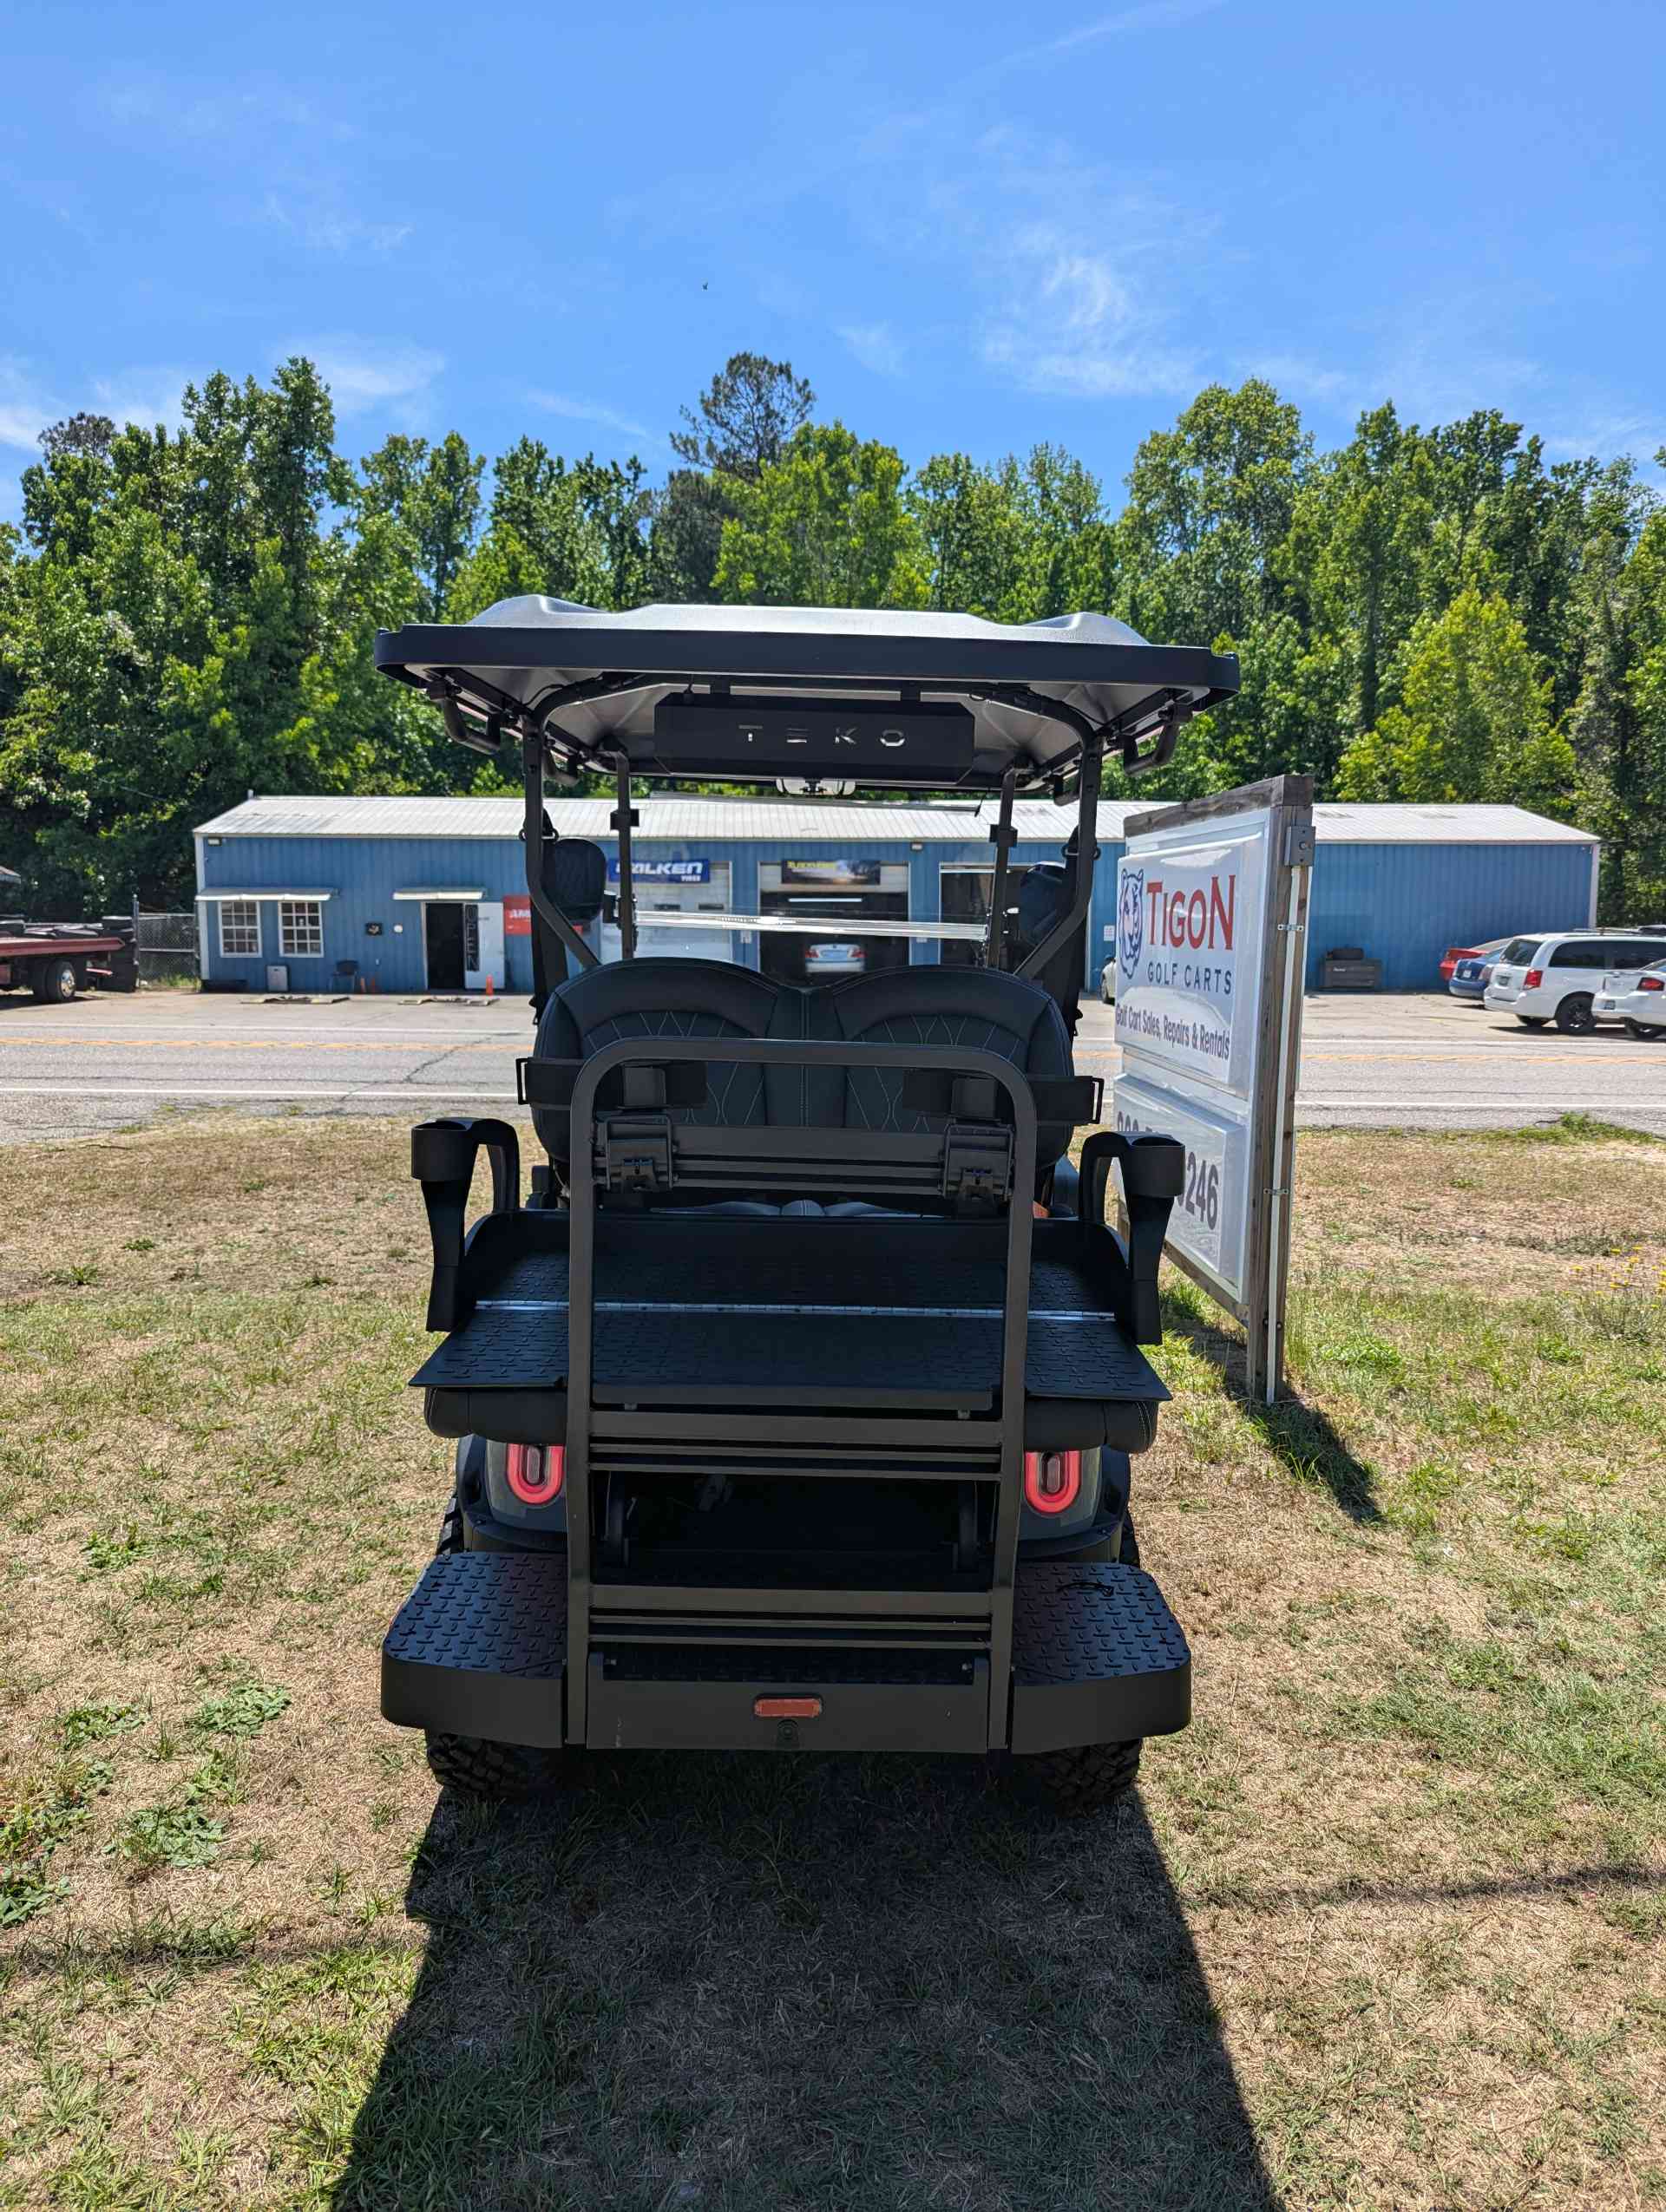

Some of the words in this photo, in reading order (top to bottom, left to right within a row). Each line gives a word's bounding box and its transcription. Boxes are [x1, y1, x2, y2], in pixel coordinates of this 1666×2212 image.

[738, 725, 906, 747] TEKO
[616, 862, 704, 874] ALKEN
[1146, 874, 1236, 951] TIGON
[1147, 961, 1178, 985] GOLF
[1184, 965, 1232, 994] CARTS
[1116, 1003, 1127, 1027] Golf
[1129, 1006, 1141, 1031] Cart
[1143, 1010, 1162, 1041] Sales,
[1164, 1015, 1190, 1048] Repairs
[1192, 1022, 1198, 1050] &
[1200, 1024, 1230, 1060] Rentals
